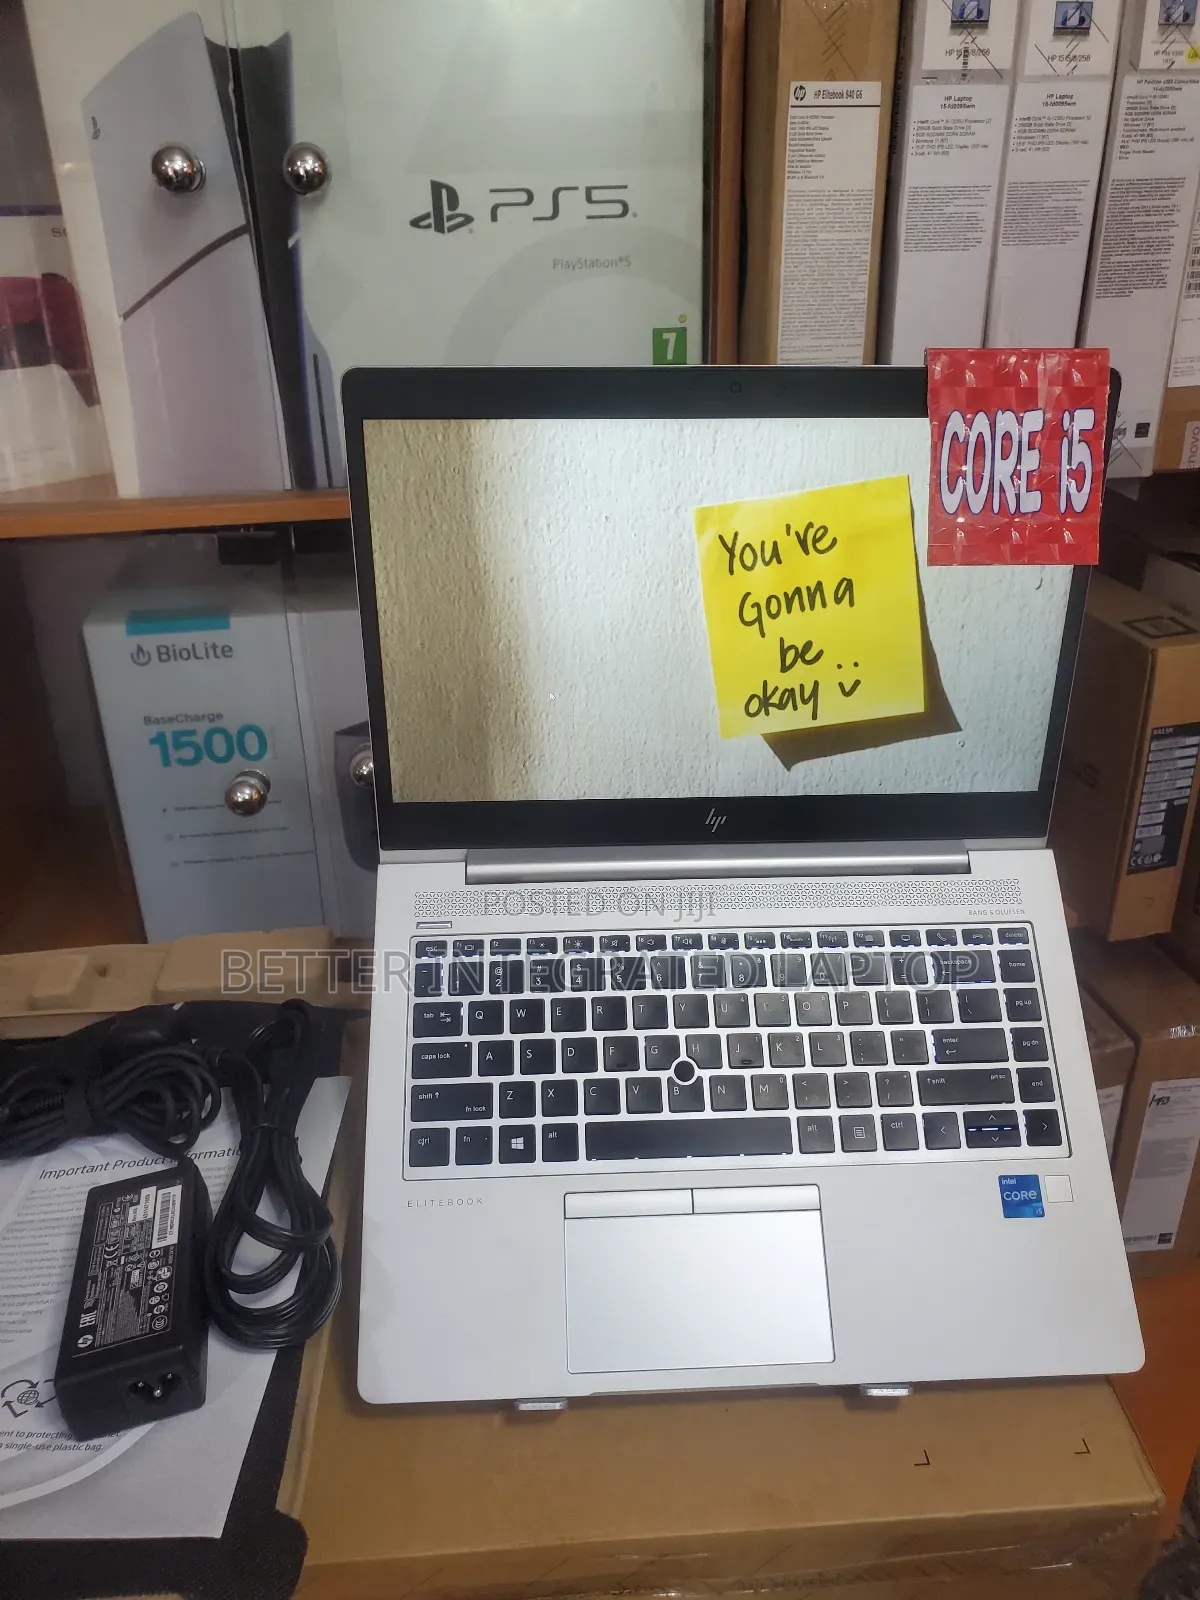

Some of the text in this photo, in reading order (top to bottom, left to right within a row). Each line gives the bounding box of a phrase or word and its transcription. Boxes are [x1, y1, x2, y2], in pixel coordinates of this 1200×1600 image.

[814, 89, 821, 99] HP
[822, 89, 844, 99] Elitebook
[846, 90, 854, 99] 840
[490, 184, 630, 222] PS5
[662, 332, 676, 360] 7
[940, 408, 1095, 515] CORE i5
[718, 521, 838, 576] You're
[738, 577, 855, 638] Gonna
[156, 642, 233, 664] BioLite
[744, 680, 820, 720] okay
[143, 712, 224, 726] BaseCharge
[148, 724, 268, 768] 1500
[495, 979, 502, 987] 2
[576, 976, 582, 984] 4
[597, 1006, 603, 1014] R
[638, 1005, 645, 1013] T
[679, 1004, 686, 1012] Y
[721, 1004, 728, 1012] U
[803, 1002, 811, 1010] O
[476, 1010, 484, 1020] Q
[516, 1009, 526, 1017] W
[556, 1007, 562, 1015] E
[651, 1046, 658, 1054] G
[693, 1044, 699, 1053] H
[736, 1044, 740, 1053] J
[776, 1043, 782, 1051] K
[817, 1042, 823, 1050] L
[526, 1050, 532, 1058] S
[567, 1048, 575, 1056] D
[609, 1047, 615, 1055] F
[485, 1052, 493, 1061] A
[548, 1089, 555, 1098] X
[590, 1087, 596, 1096] C
[632, 1086, 639, 1094] V
[674, 1087, 679, 1095] B
[718, 1086, 725, 1094] N
[759, 1085, 769, 1094] M
[507, 1091, 513, 1100] Z
[39, 1162, 110, 1180] Important
[113, 1156, 166, 1170] Product
[407, 1198, 483, 1207] ELITEBOOK
[26, 1431, 72, 1440] protecting
[5, 1442, 51, 1451] single-use
[52, 1443, 82, 1452] plastic
